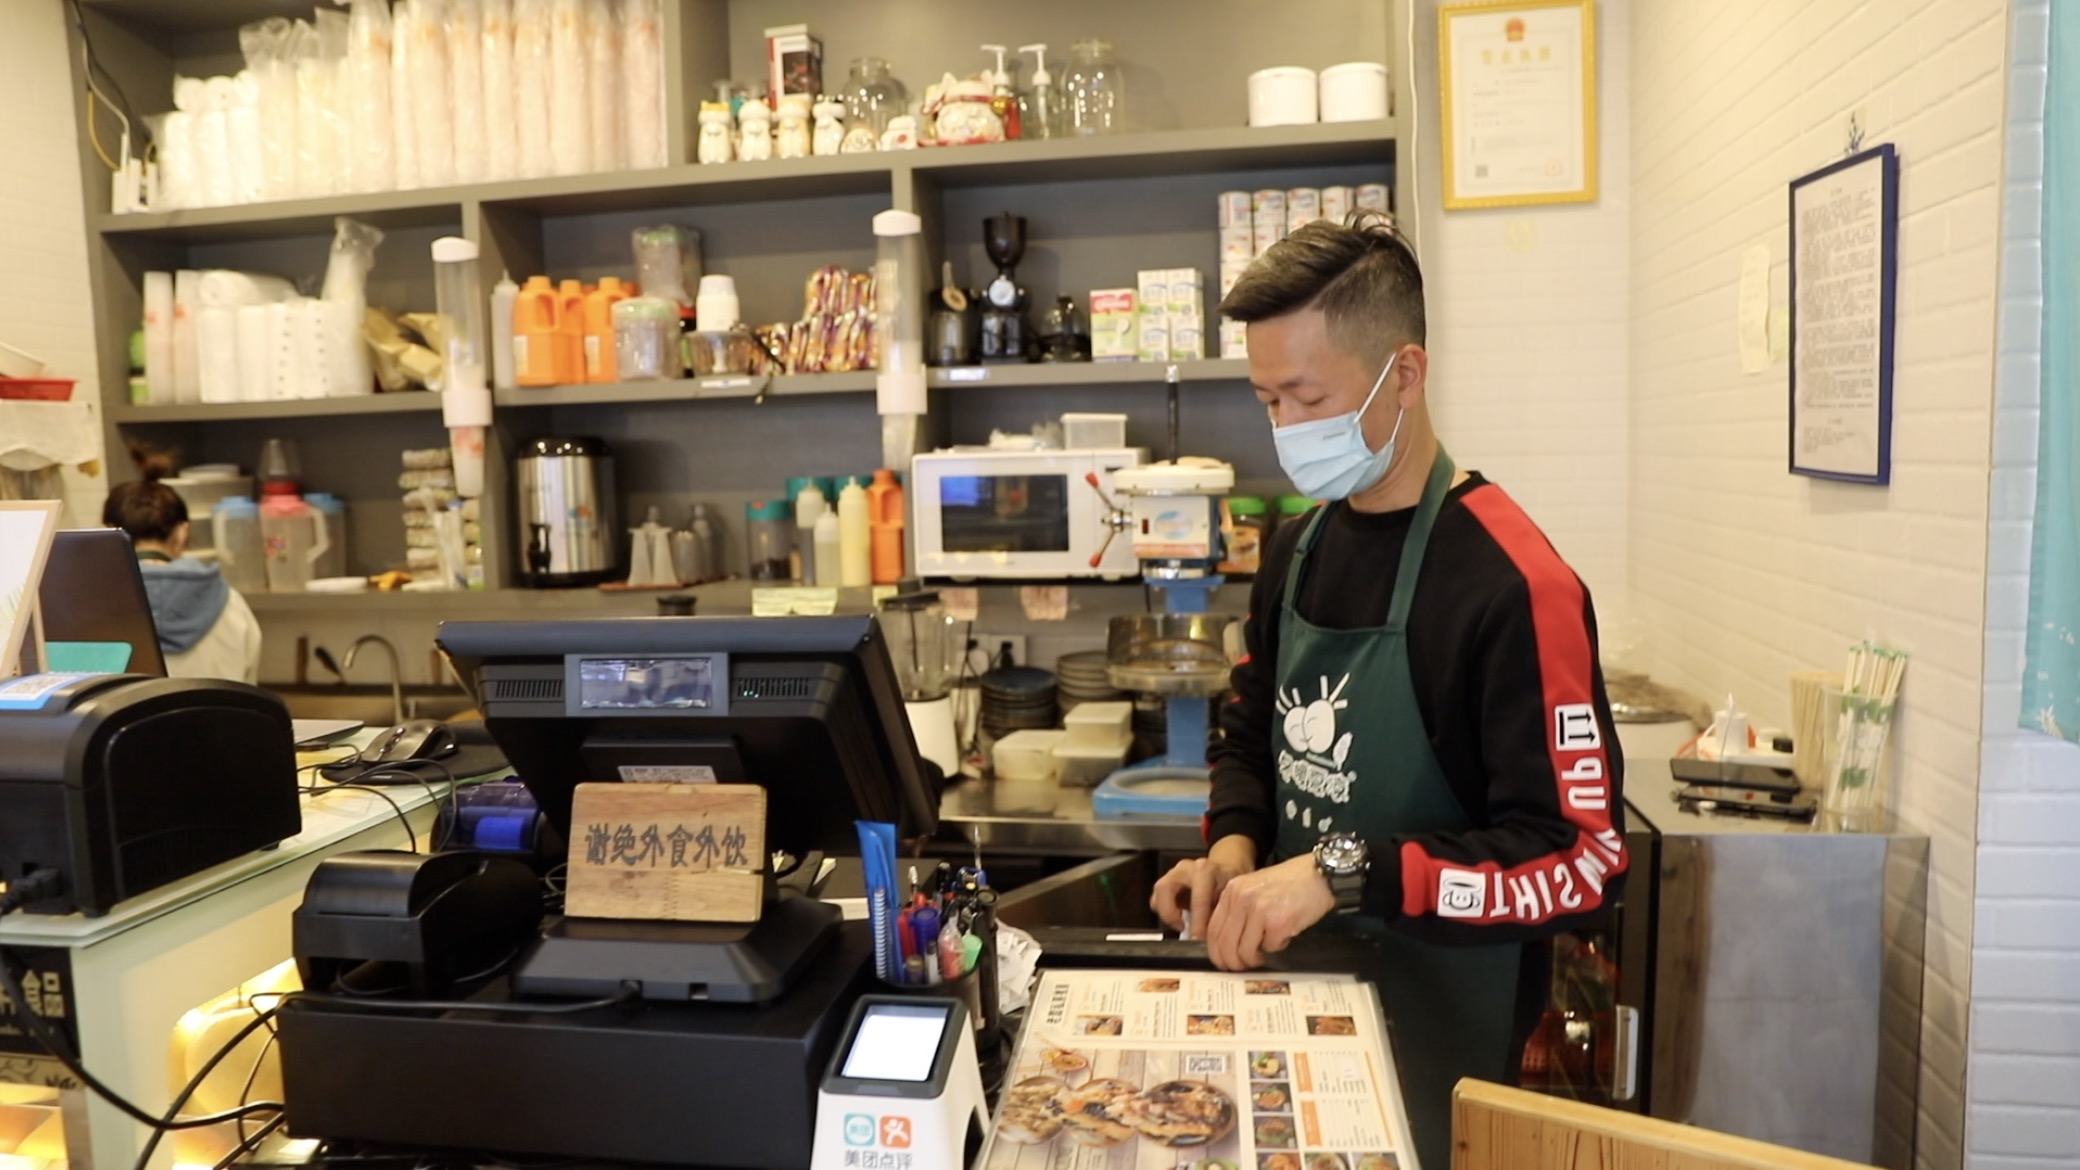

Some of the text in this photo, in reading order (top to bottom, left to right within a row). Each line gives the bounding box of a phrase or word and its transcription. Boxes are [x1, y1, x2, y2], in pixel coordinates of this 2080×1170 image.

[585, 823, 749, 868] 谢绝外食外饮
[844, 1149, 913, 1170] 美团点评
